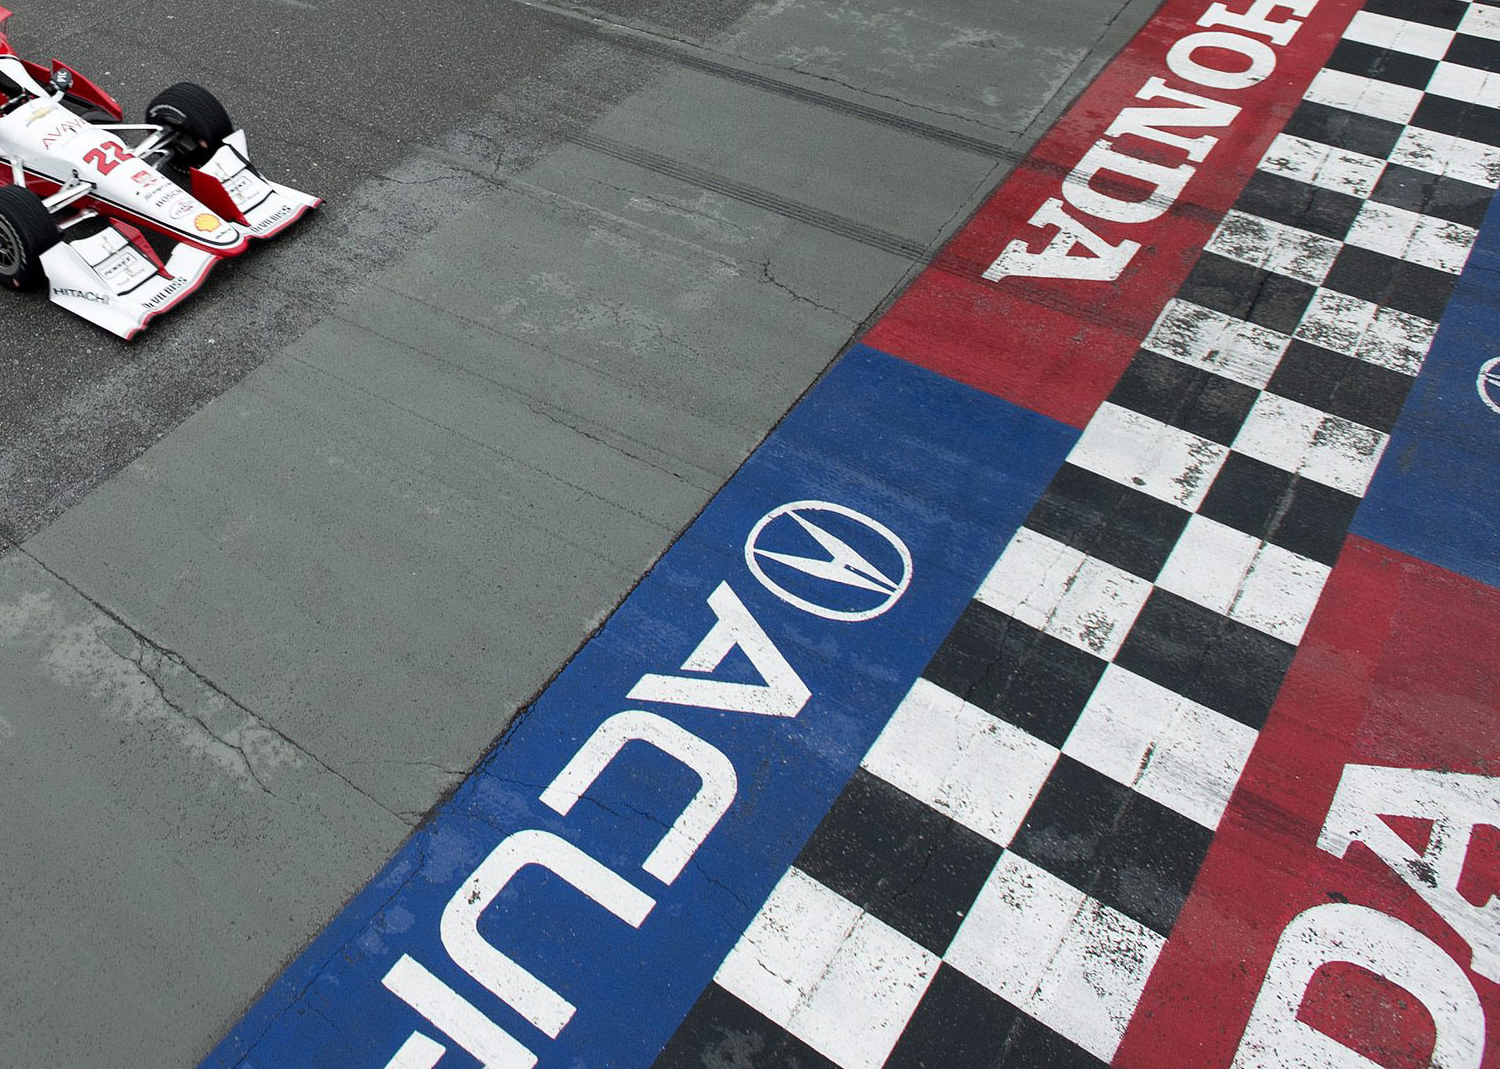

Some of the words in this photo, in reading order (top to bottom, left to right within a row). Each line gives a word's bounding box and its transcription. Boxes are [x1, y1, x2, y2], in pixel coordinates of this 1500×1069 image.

[42, 119, 88, 151] AVAYA
[83, 140, 134, 176] 22
[53, 287, 110, 305] HITACHI
